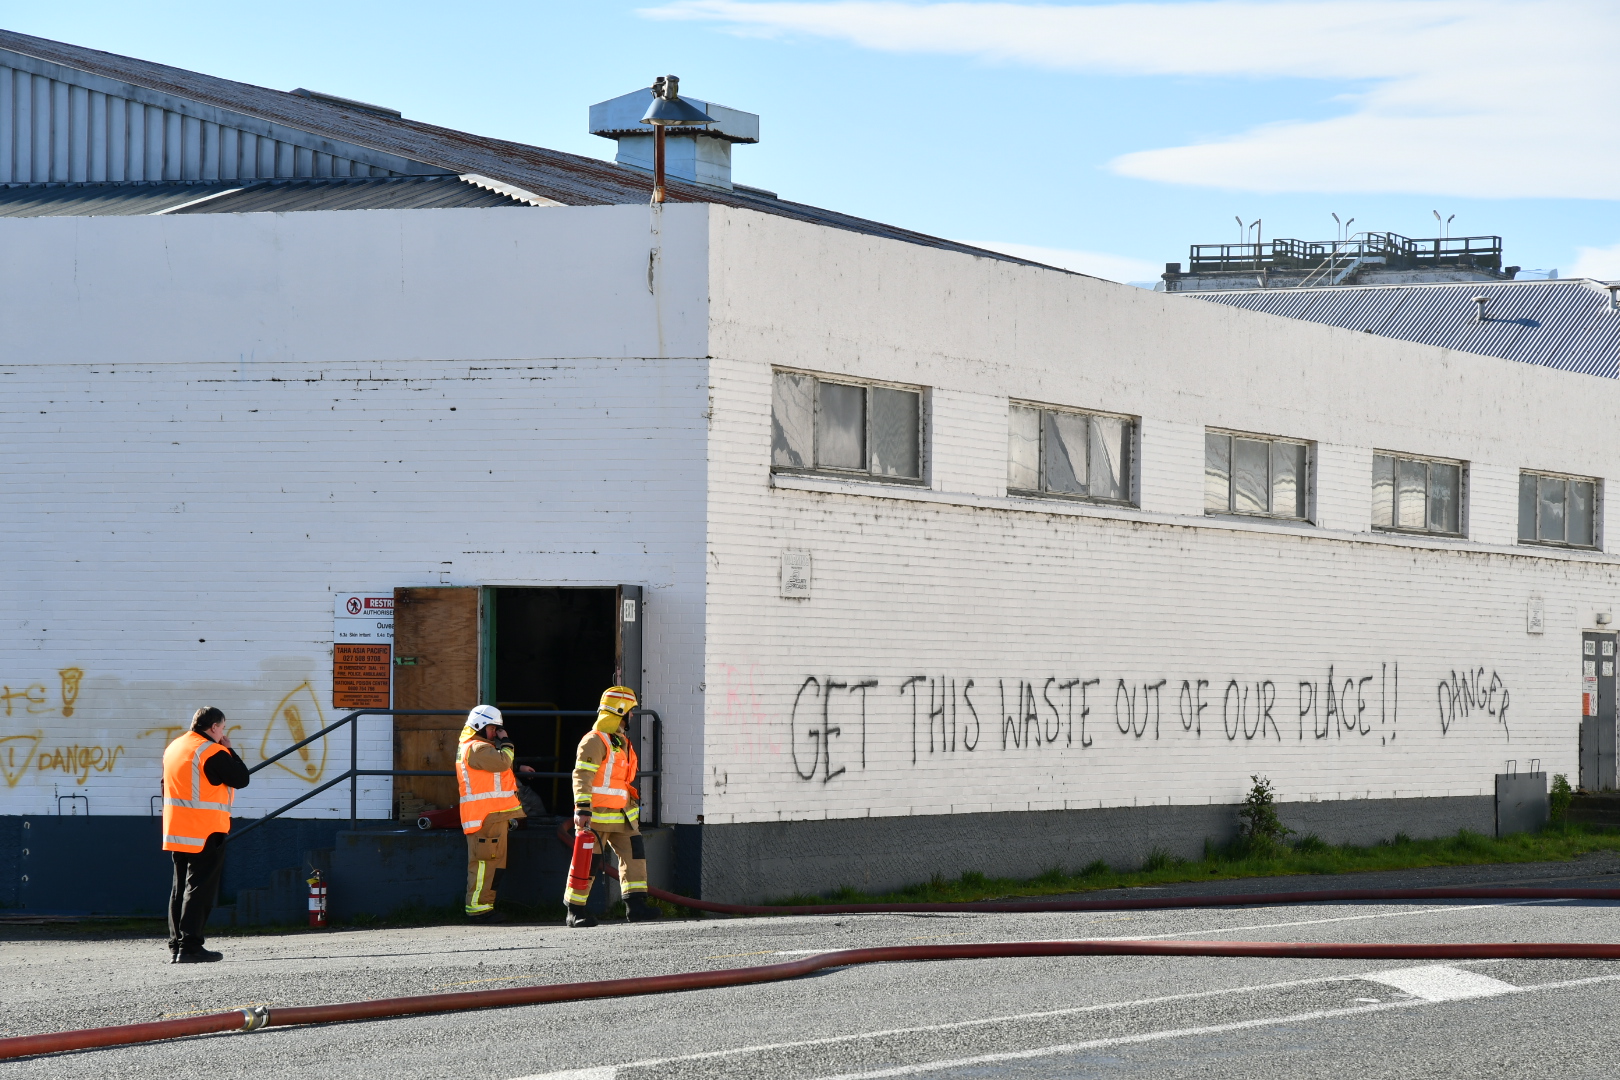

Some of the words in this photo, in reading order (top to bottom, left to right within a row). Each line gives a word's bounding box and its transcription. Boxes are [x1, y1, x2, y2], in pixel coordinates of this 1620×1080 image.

[625, 603, 634, 618] EXIT
[1603, 643, 1612, 654] EXIT
[1436, 666, 1511, 743] DANGER
[791, 675, 879, 784] GET
[899, 674, 980, 767] THIS
[999, 676, 1100, 751] WASTE
[1114, 677, 1167, 741] OUT
[1179, 678, 1211, 739] OF
[1223, 679, 1282, 742] OUR
